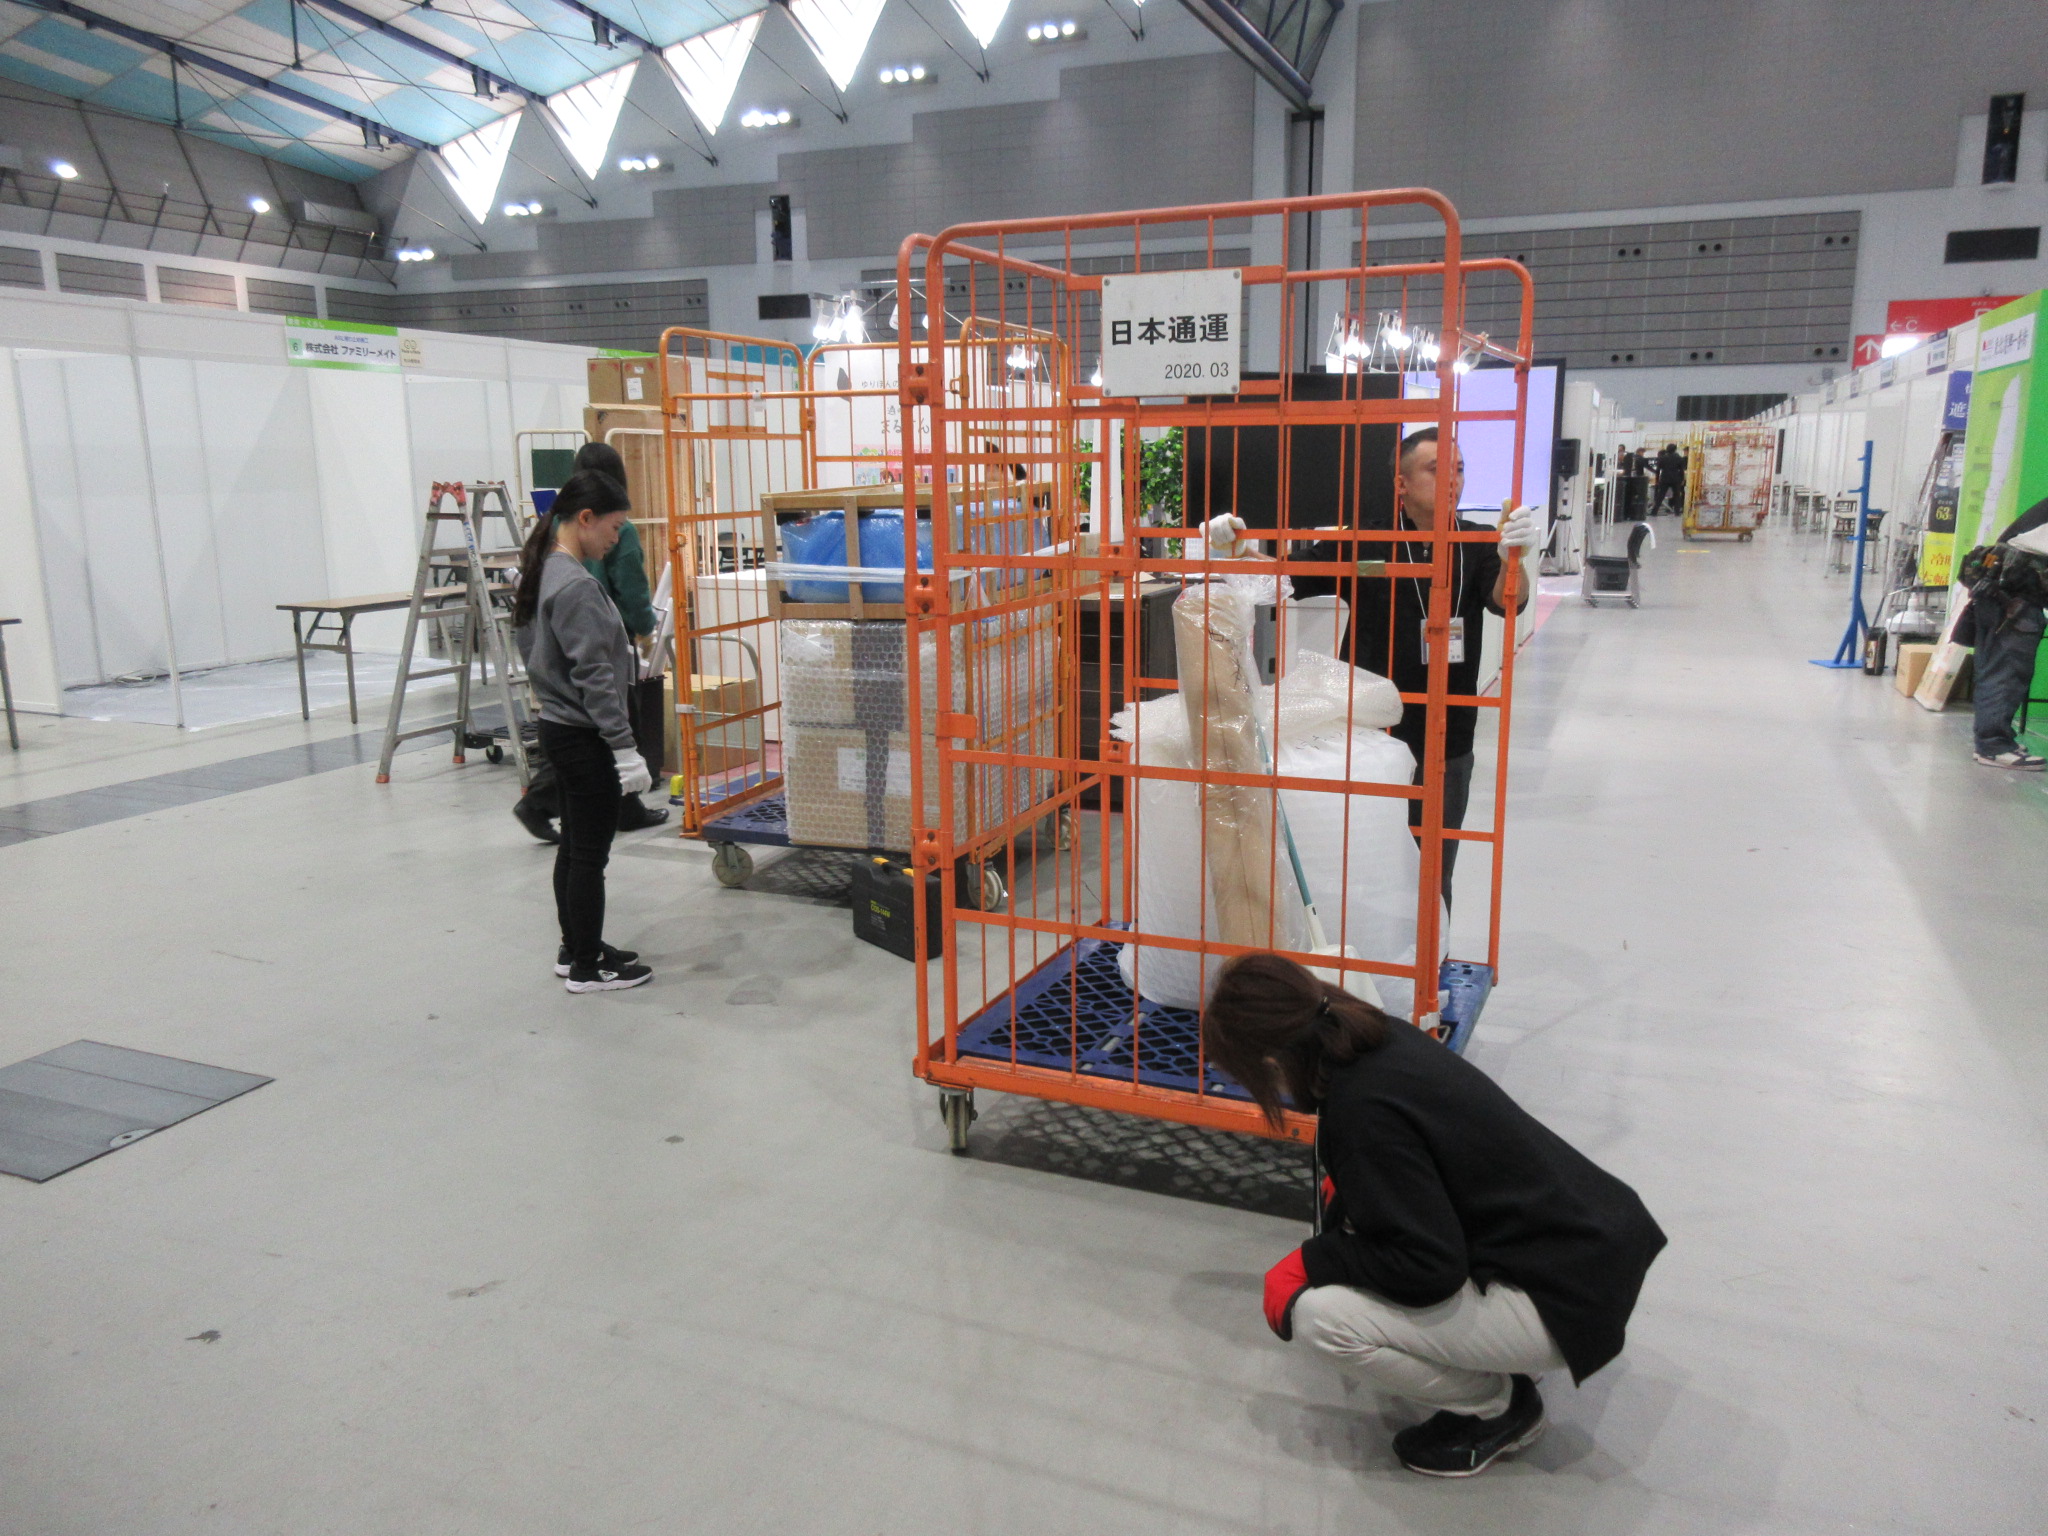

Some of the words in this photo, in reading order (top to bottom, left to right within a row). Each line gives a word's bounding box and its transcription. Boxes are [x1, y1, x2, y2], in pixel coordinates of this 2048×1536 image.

[1111, 313, 1229, 345] 日本通運
[293, 342, 299, 352] 6
[305, 342, 339, 355] 株式会社
[341, 345, 397, 360] ファミリーメイト
